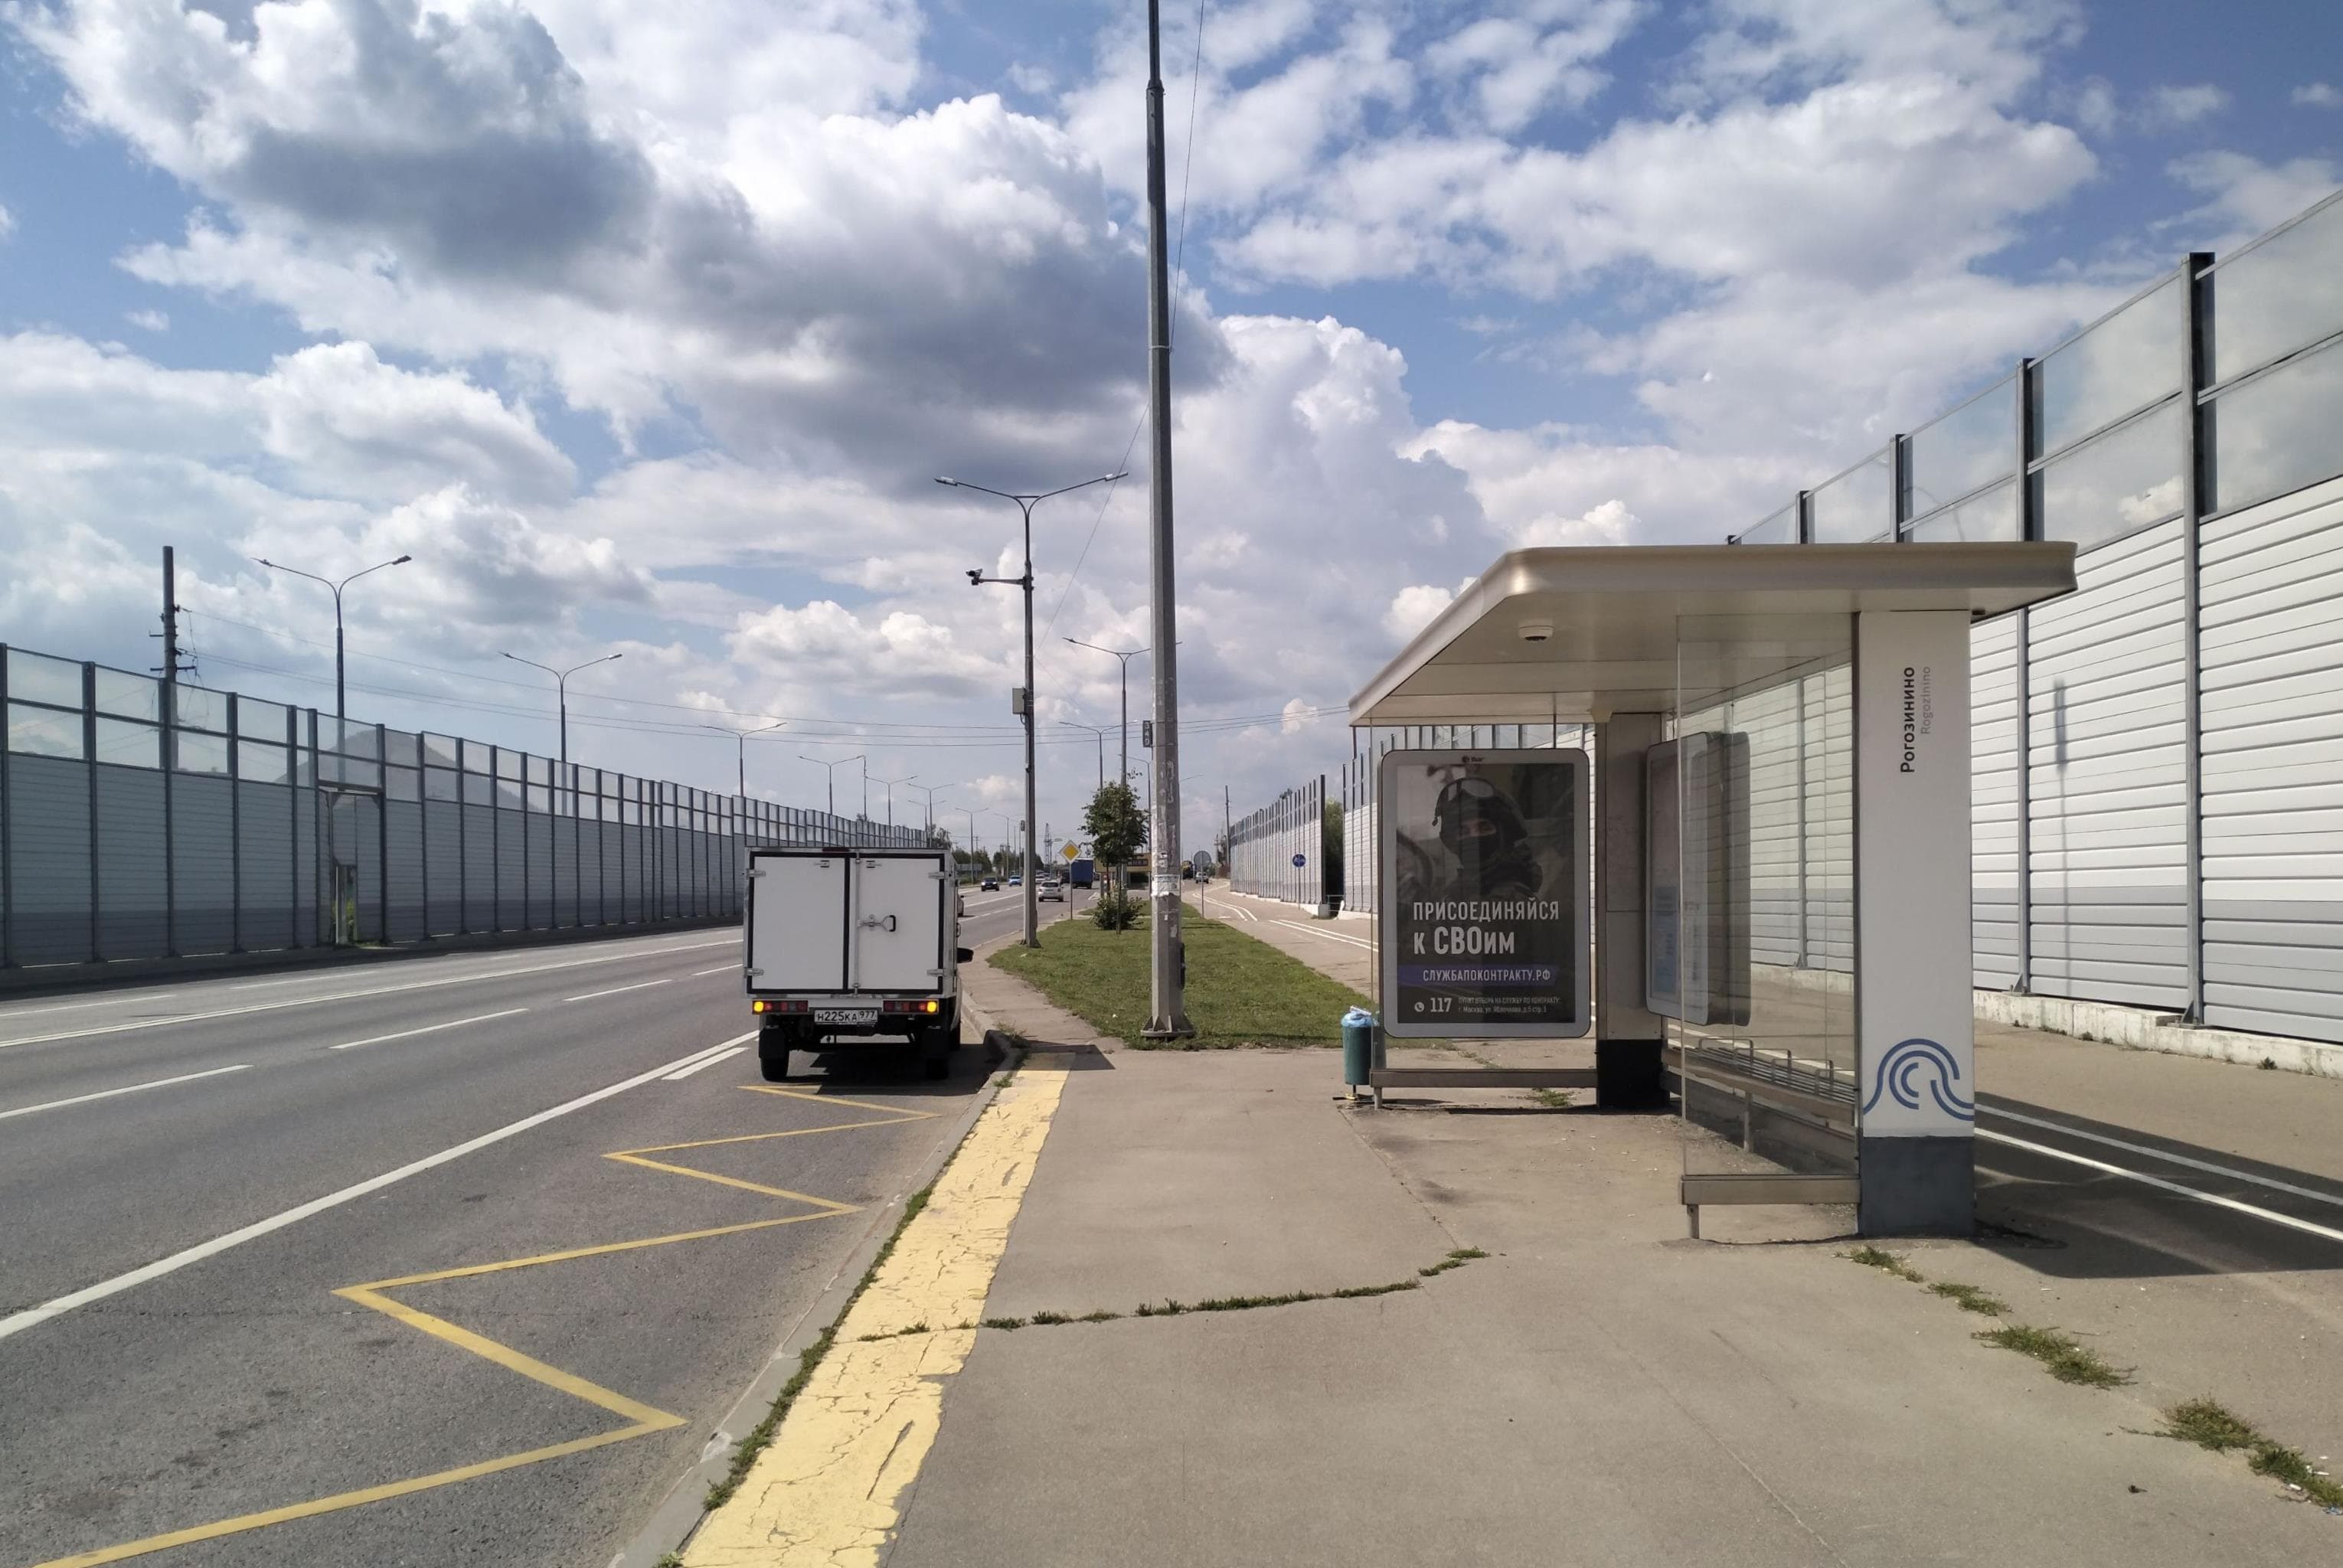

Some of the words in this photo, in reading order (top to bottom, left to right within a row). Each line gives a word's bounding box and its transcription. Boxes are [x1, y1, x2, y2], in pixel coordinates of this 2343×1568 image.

[1920, 666, 1933, 734] Rogozinino
[1900, 667, 1915, 773] Рогозинино
[1413, 897, 1559, 922] ПРИСОЕДИНЯЙСЯ
[1423, 969, 1551, 982] СЛУЖБАПОКОНТРАКТУ.РФ
[1430, 998, 1453, 1014] 117
